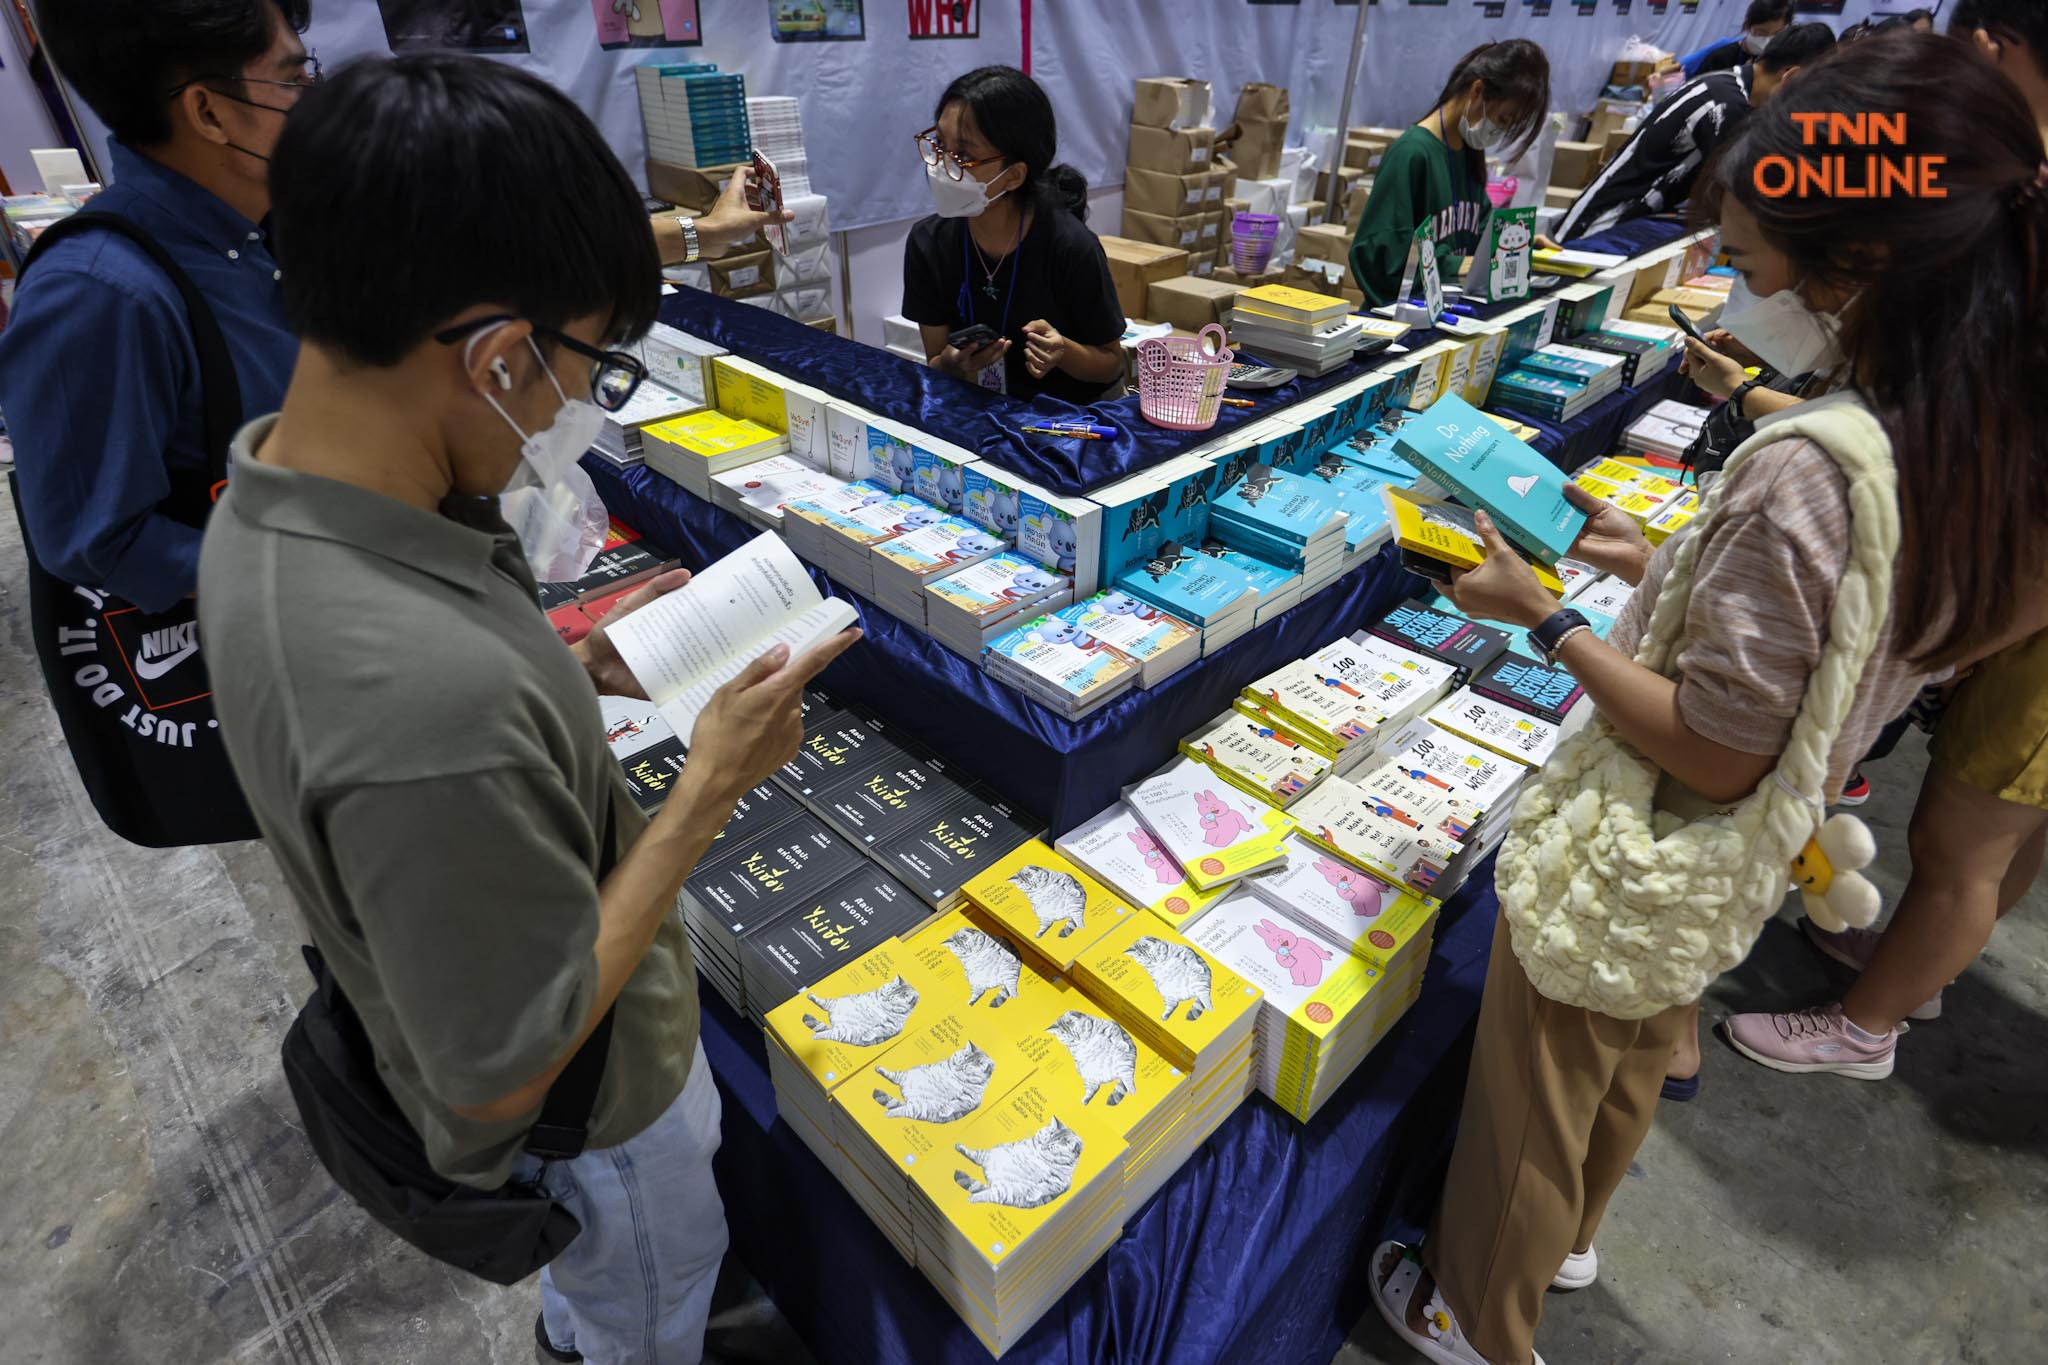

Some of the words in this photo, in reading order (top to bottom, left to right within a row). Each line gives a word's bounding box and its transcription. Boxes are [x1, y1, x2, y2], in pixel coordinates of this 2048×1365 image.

[1436, 422, 1460, 439] Do
[1443, 425, 1491, 464] Nothing
[1407, 451, 1422, 467] Do
[1422, 462, 1463, 497] Nothing
[1383, 606, 1422, 628] SKILL
[1397, 611, 1444, 638] BEFORE
[1414, 616, 1467, 649] PASSION
[1332, 657, 1356, 674] 100
[1492, 661, 1530, 686] SKILL
[75, 664, 125, 708] DO
[1284, 681, 1298, 692] How
[1511, 666, 1555, 698] BEFORE
[1294, 685, 1312, 696] Make
[1302, 689, 1318, 700] Work
[1377, 679, 1412, 702] WRITING
[1532, 672, 1578, 710] PASSION
[1313, 695, 1325, 704] Not
[1320, 699, 1336, 710] Suck
[1463, 704, 1487, 724] 100
[120, 703, 197, 748] JUST
[1217, 734, 1232, 745] How
[1230, 731, 1239, 739] to
[1228, 737, 1246, 749] Make
[1519, 726, 1549, 752] WRITING
[1236, 742, 1252, 754] Work
[1248, 748, 1261, 757] Not
[1411, 738, 1435, 759] 100
[1256, 752, 1272, 764] Suck
[1372, 777, 1386, 788] How
[1464, 762, 1497, 791] WRITING
[1381, 779, 1398, 792] Make
[1390, 785, 1407, 796] Work
[1403, 790, 1415, 800] Not
[1412, 795, 1428, 807] Suck
[1335, 814, 1349, 827] How
[1346, 810, 1355, 818] to
[1346, 818, 1364, 832] Make
[1356, 824, 1373, 838] Work
[1369, 830, 1383, 841] Not
[1379, 835, 1396, 849] Suck
[1210, 932, 1222, 944] 100
